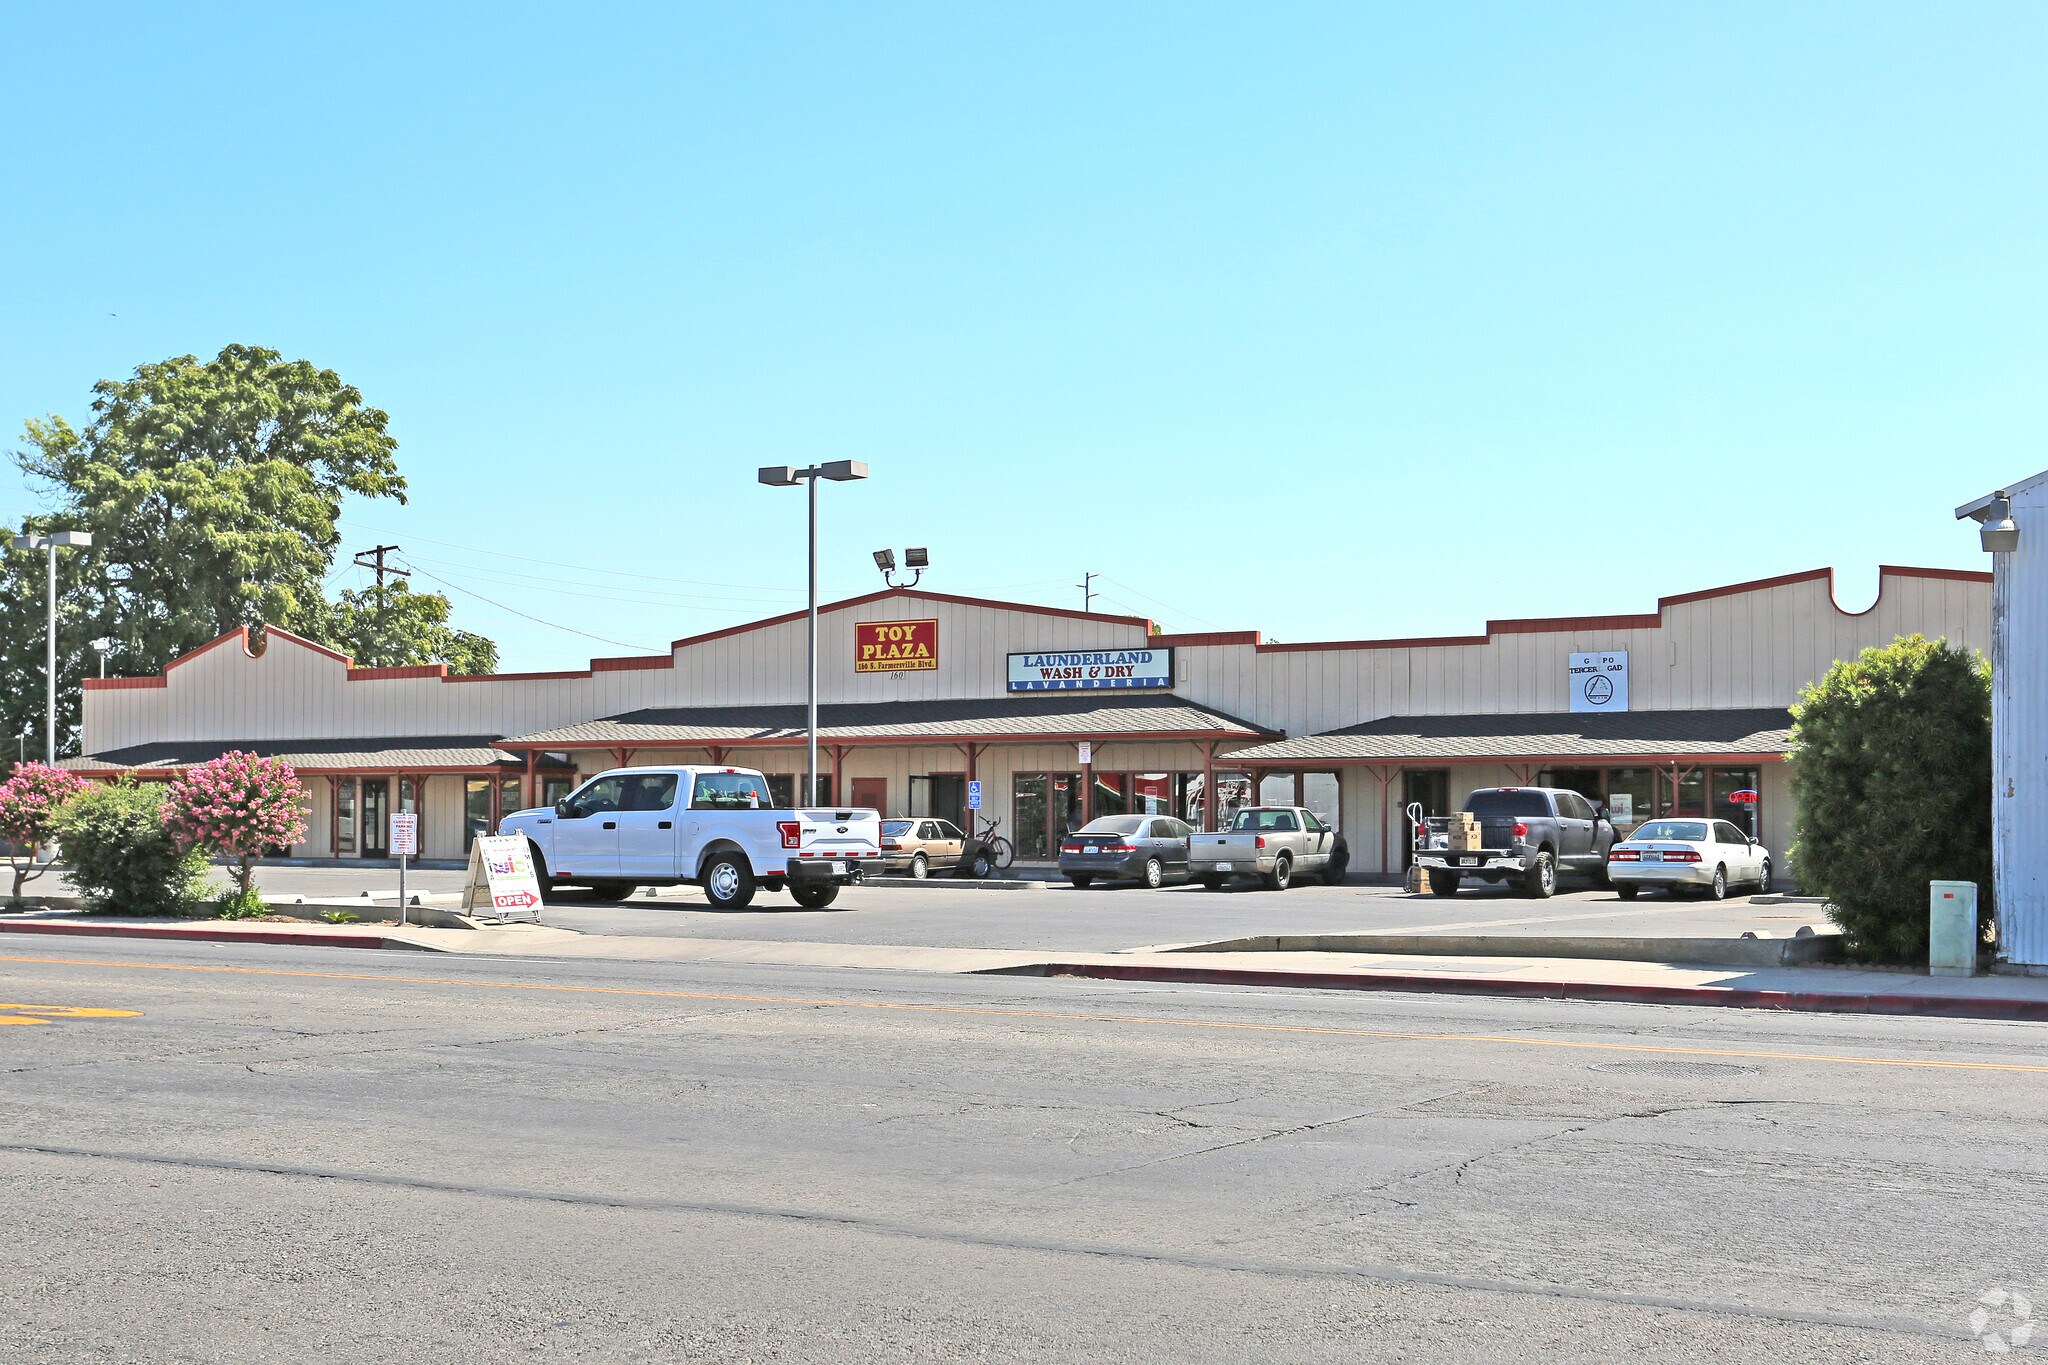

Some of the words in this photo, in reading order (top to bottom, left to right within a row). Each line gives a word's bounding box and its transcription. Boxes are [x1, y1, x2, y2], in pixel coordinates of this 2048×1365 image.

[875, 625, 917, 642] TOY
[862, 642, 930, 660] PLAZA
[870, 662, 876, 670] S.
[877, 660, 916, 670] Farmersville
[917, 659, 935, 668] Blvd.
[1023, 651, 1153, 668] LAUNDERLAND
[1040, 667, 1083, 680] WASH
[1088, 666, 1100, 679] &
[1104, 665, 1135, 678] DRY
[1569, 666, 1598, 674] TERCER
[1607, 664, 1623, 672] GAD
[890, 671, 904, 680] 160
[1012, 677, 1165, 690] LAVANDERIA
[1729, 792, 1758, 803] OPEN
[497, 895, 532, 906] OPEN
